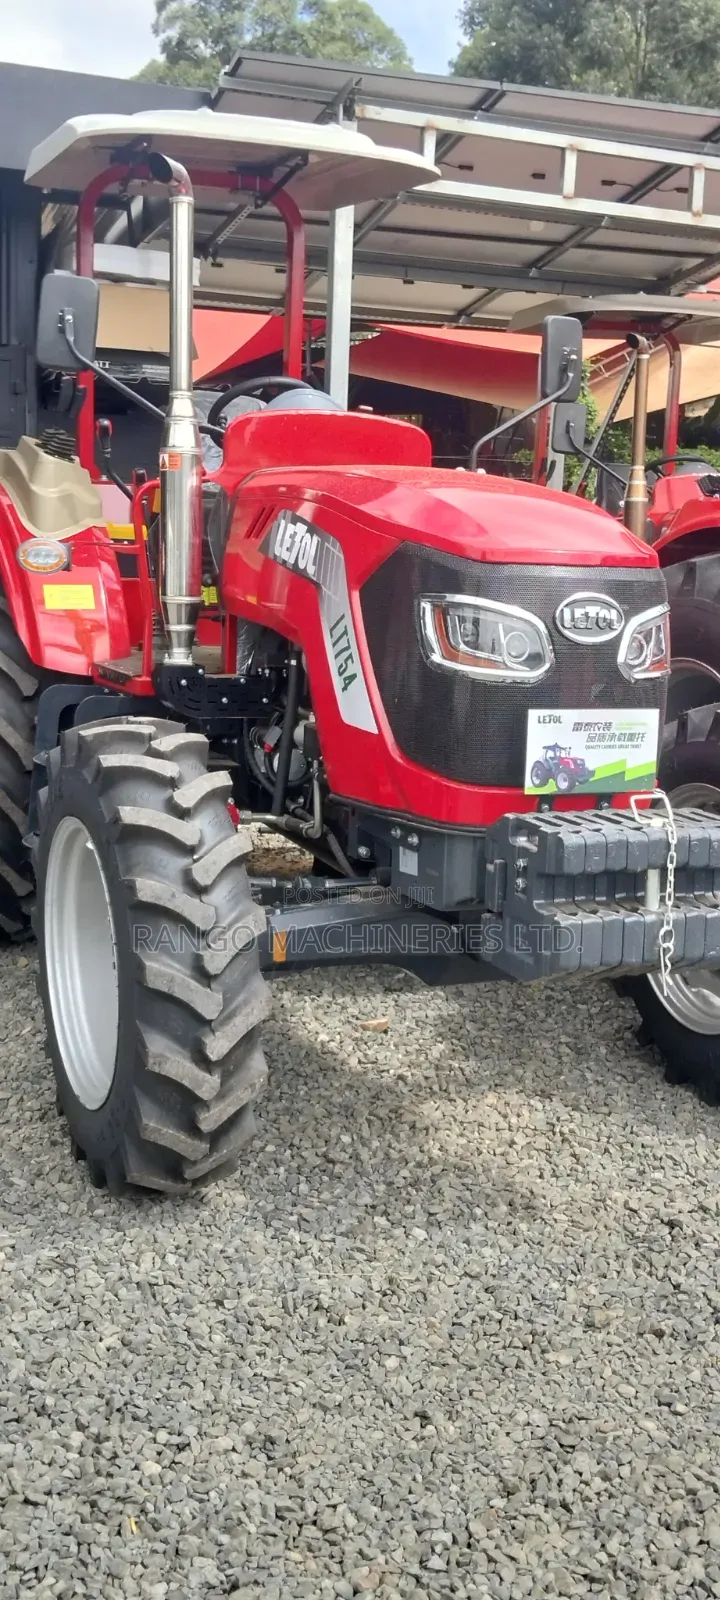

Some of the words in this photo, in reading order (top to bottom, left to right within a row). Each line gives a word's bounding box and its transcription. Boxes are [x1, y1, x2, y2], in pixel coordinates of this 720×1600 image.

[274, 519, 319, 575] LETOL
[563, 606, 620, 630] LETOL
[329, 613, 358, 692] LT754
[537, 714, 563, 724] LETOL
